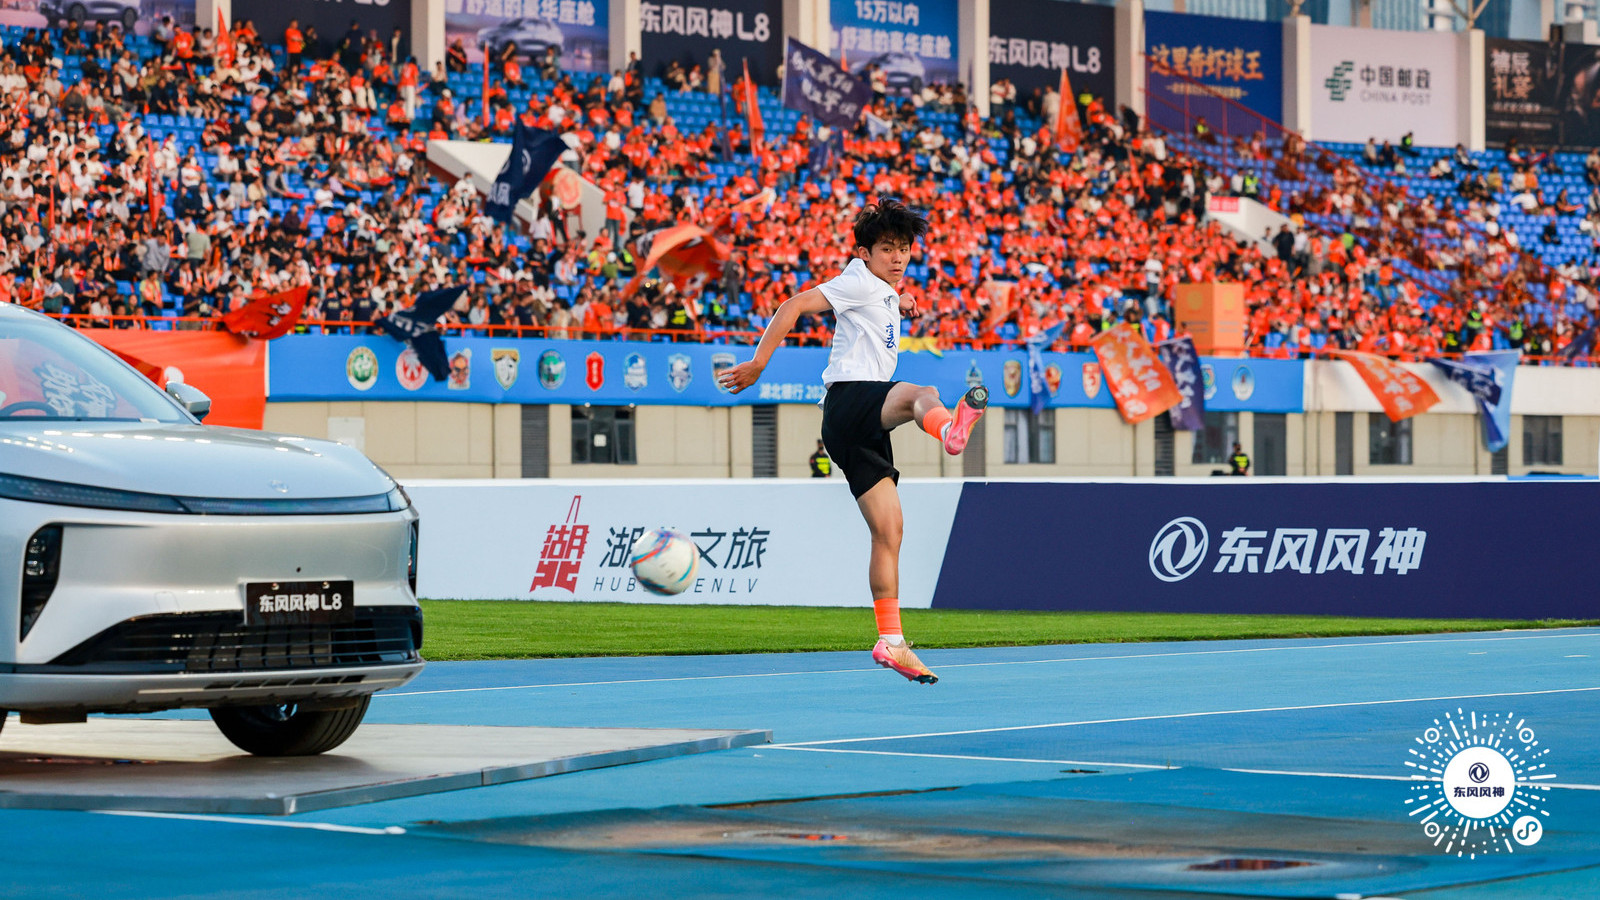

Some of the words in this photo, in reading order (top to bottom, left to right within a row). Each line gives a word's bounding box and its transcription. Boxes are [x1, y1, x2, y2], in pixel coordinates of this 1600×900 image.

[641, 2, 770, 42] 东风风神L8
[855, 1, 920, 27] 15万以内
[989, 36, 1101, 74] 东风风神L8
[1360, 63, 1431, 89] 中国邮政
[1360, 90, 1399, 103] CHINA
[1402, 92, 1433, 106] POST
[759, 383, 803, 400] 湖北银行
[599, 526, 770, 569] 湖文旅
[1212, 527, 1427, 575] 东风风神
[259, 593, 342, 612] 东风风神L8
